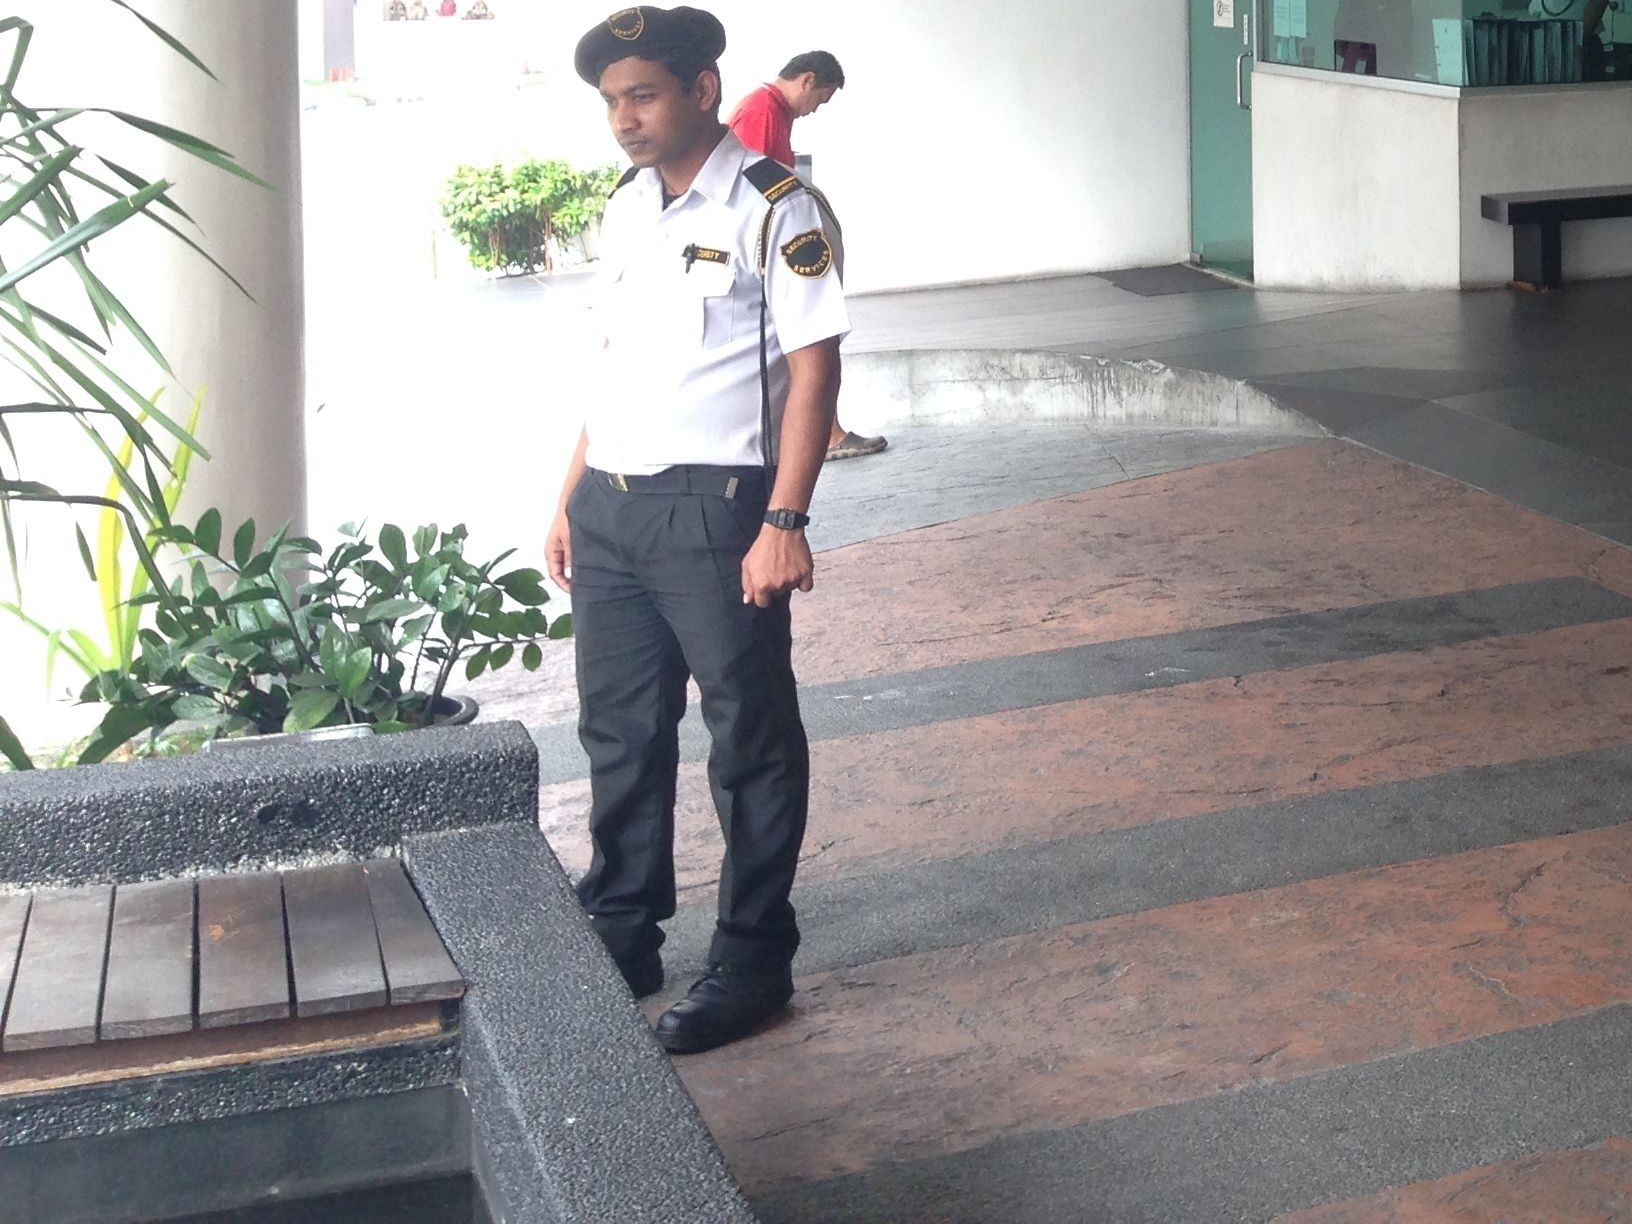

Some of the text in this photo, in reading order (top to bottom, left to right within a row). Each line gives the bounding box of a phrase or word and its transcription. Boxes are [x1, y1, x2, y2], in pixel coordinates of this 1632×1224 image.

[767, 180, 797, 200] SECURITY
[786, 235, 817, 255] SECURITY
[794, 250, 829, 273] SERVICES
